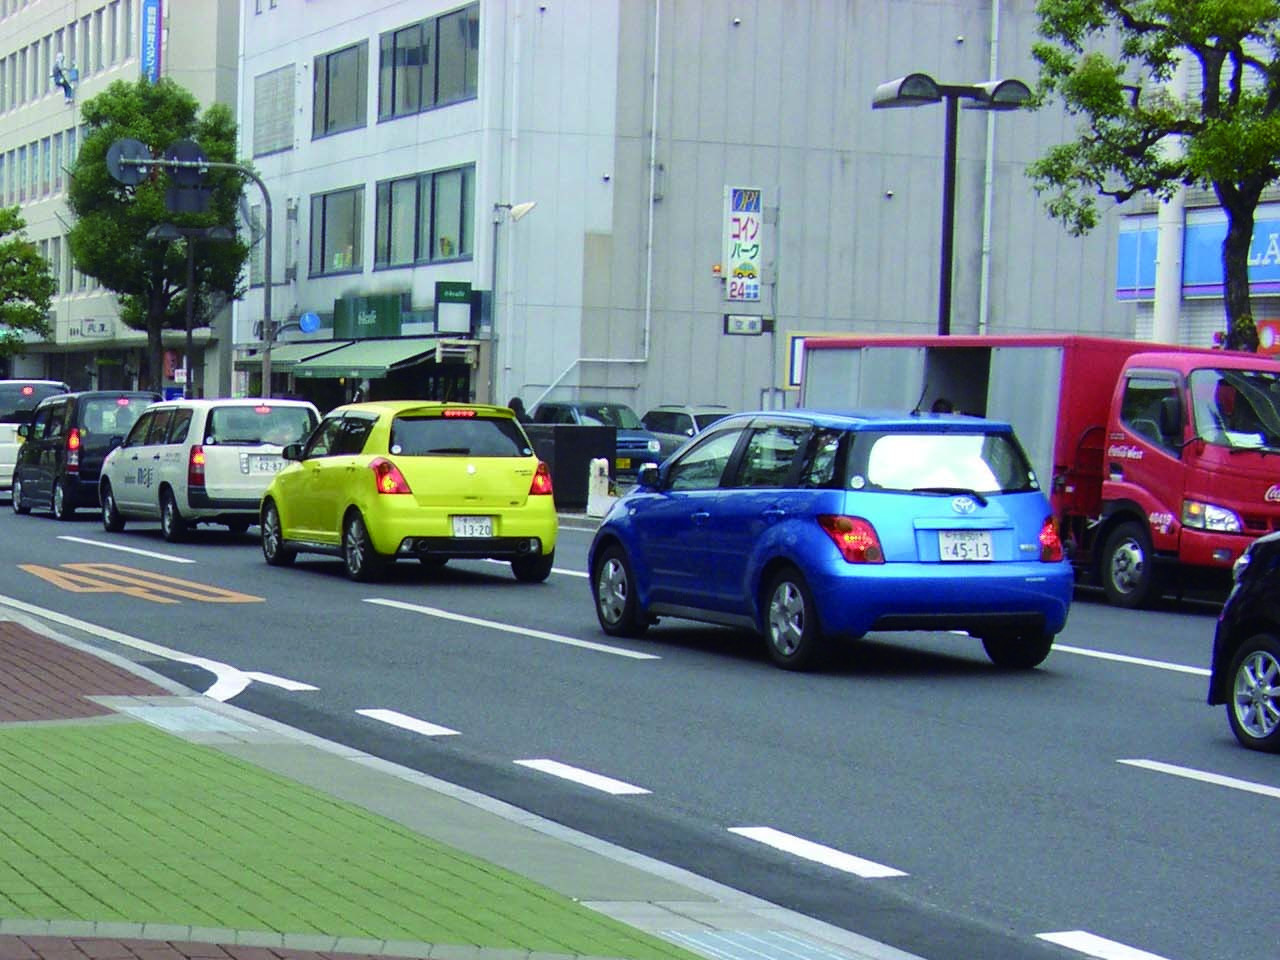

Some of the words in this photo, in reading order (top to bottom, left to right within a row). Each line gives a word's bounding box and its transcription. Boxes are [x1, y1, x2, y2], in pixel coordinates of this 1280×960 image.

[732, 217, 759, 241] コイン
[730, 281, 745, 299] 24
[463, 525, 490, 536] 13-20
[952, 543, 990, 558] 45-13
